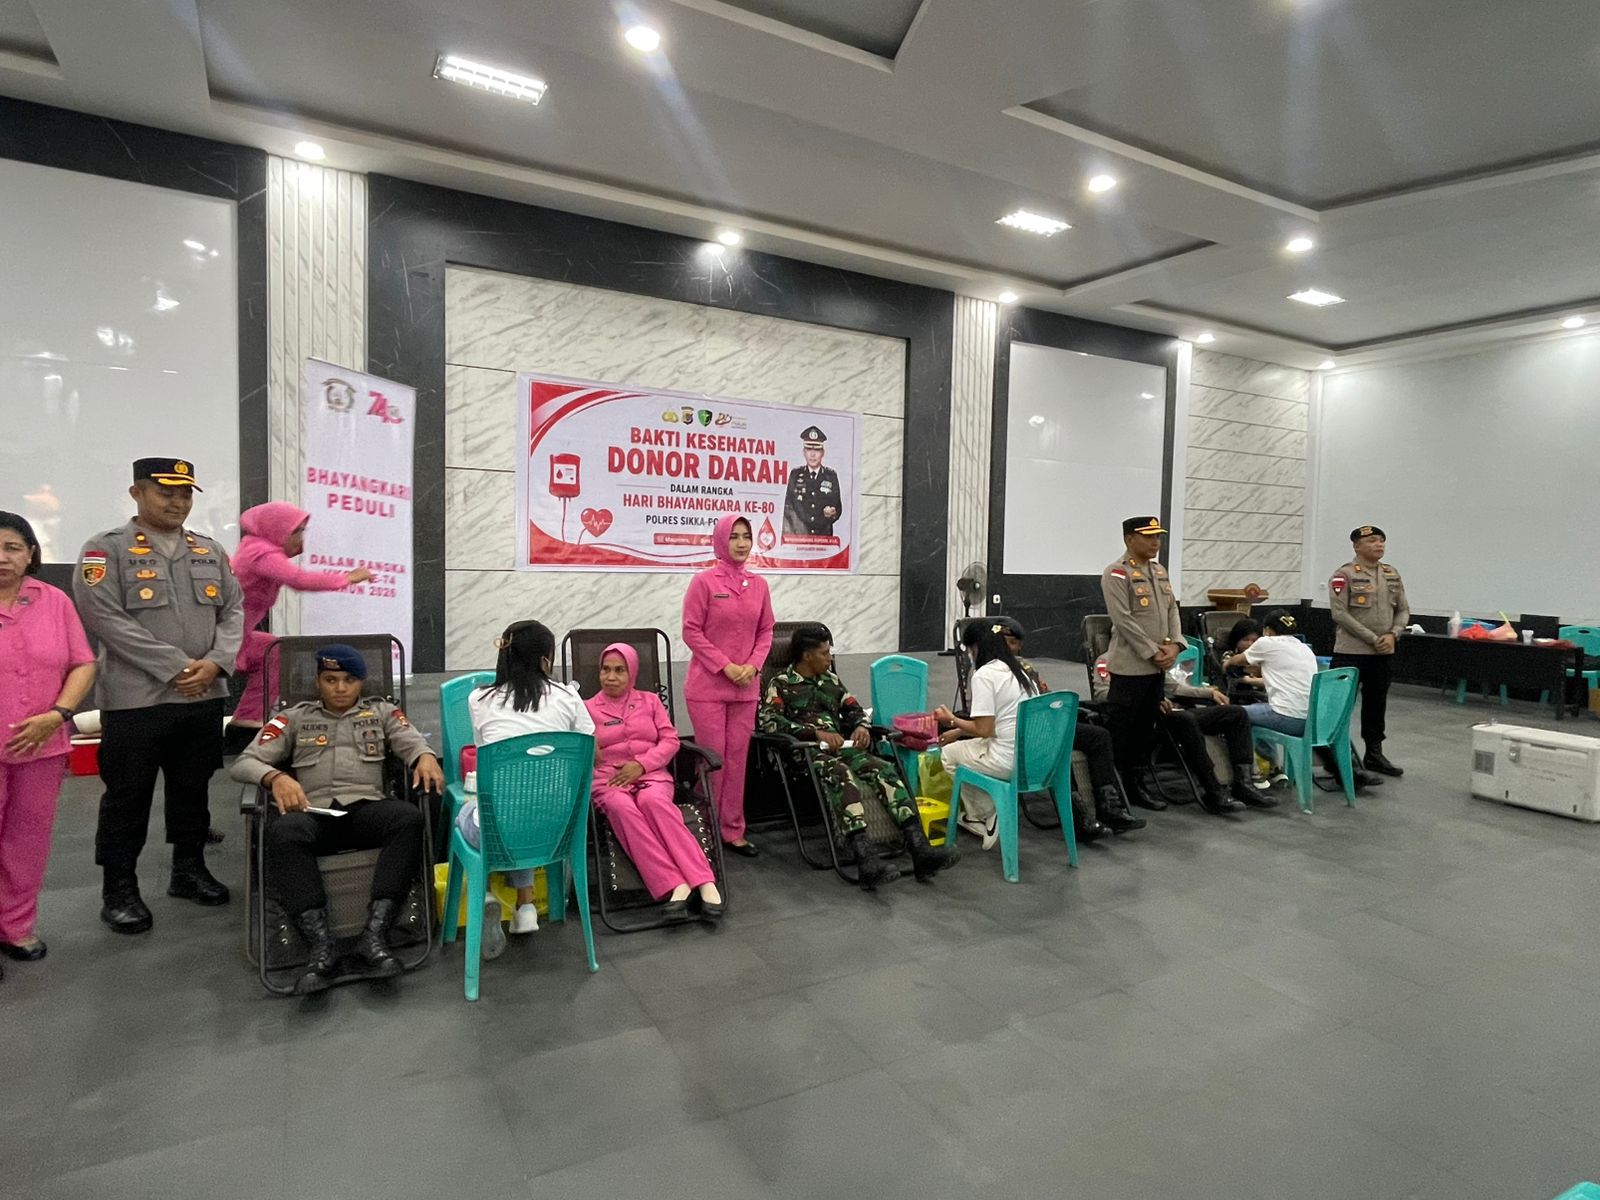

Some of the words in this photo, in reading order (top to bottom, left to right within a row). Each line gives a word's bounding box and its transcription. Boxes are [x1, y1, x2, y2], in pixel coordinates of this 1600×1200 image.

[630, 427, 681, 448] BAKTI
[686, 432, 775, 456] KESEHATAN
[608, 446, 700, 479] DONOR
[708, 454, 788, 485] DARAH
[670, 483, 699, 494] DALAM
[701, 486, 734, 496] RANGKA
[327, 493, 395, 518] PEDULI
[623, 493, 653, 508] HARI
[657, 495, 741, 512] BHAYANGKARA
[744, 501, 775, 514] KE-80
[645, 514, 679, 525] POLRES
[680, 516, 718, 527] SIKKA-PO
[310, 554, 355, 567] DALAM
[360, 559, 406, 574] RANGKA
[369, 573, 396, 584] E-74
[353, 718, 379, 729] POLRI
